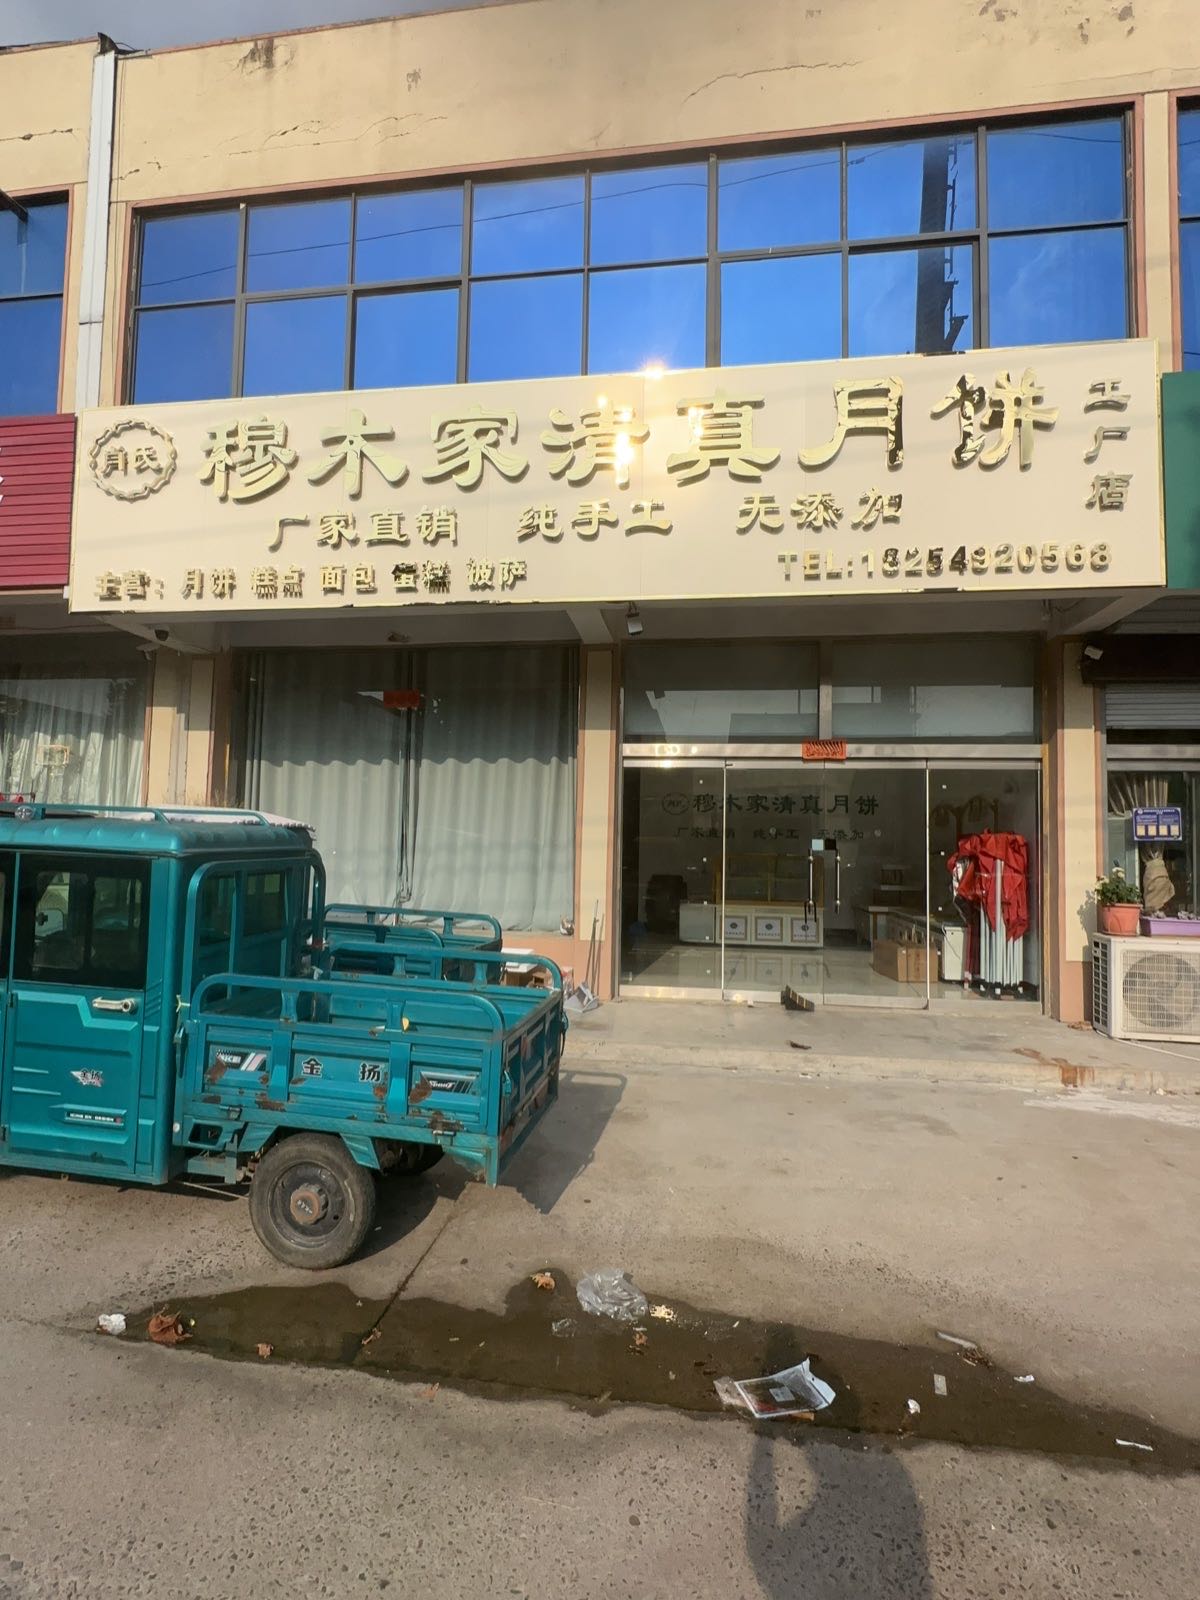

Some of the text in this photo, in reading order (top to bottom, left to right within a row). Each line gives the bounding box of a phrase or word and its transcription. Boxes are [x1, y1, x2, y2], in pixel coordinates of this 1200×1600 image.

[199, 367, 1059, 502] 穆木家清真月饼
[1083, 379, 1133, 512] 工厂店
[266, 486, 904, 553] 厂家直销 纯手工 无添加
[181, 567, 237, 600] 月饼
[250, 563, 305, 600] 糕点
[320, 562, 378, 596] 面包
[391, 560, 451, 595] 蛋糕
[777, 542, 1112, 581] TEL:18254920568
[302, 1056, 382, 1083] 金扬
